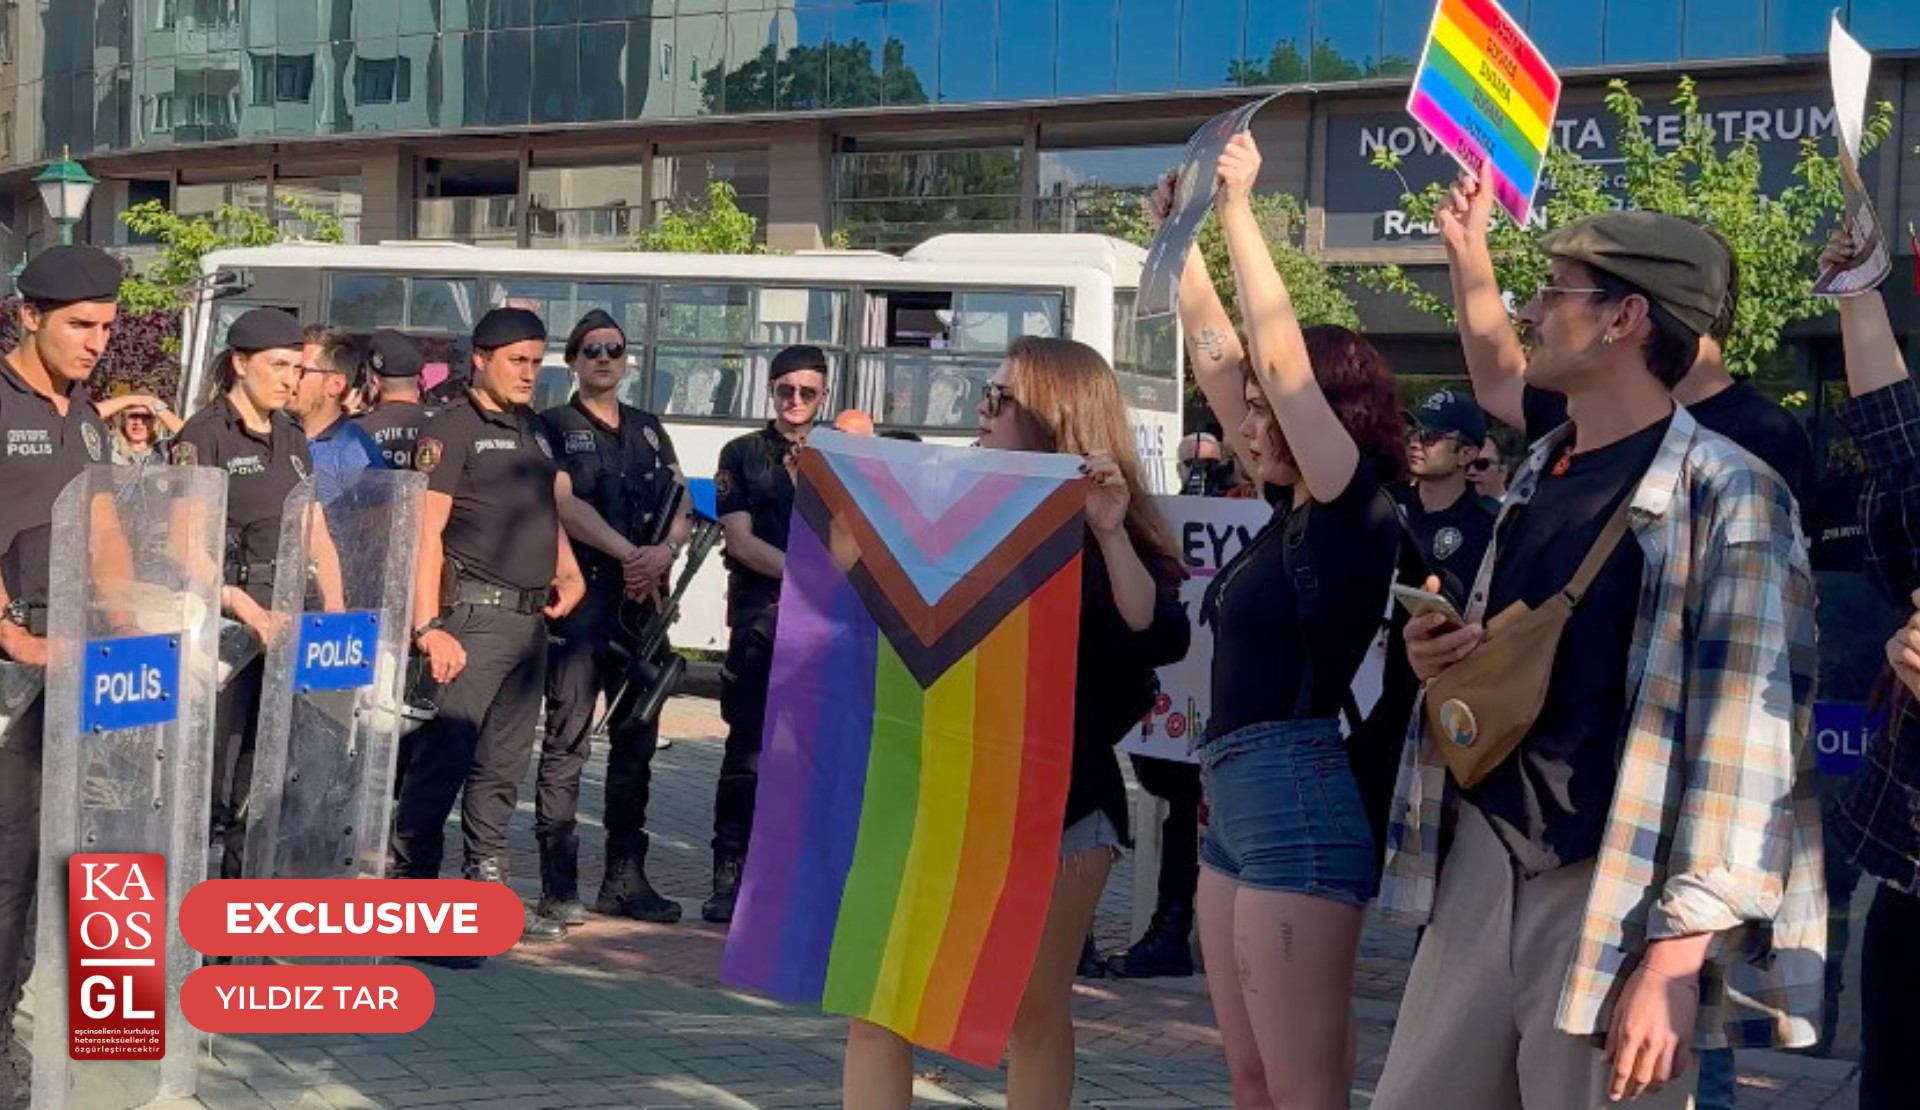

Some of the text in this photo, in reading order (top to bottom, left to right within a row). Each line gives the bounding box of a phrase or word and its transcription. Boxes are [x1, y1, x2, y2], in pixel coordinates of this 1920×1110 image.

[1359, 126, 1447, 156] NOV
[306, 635, 362, 668] POLİS
[95, 664, 161, 705] POLİS
[1816, 727, 1869, 757] OLİ
